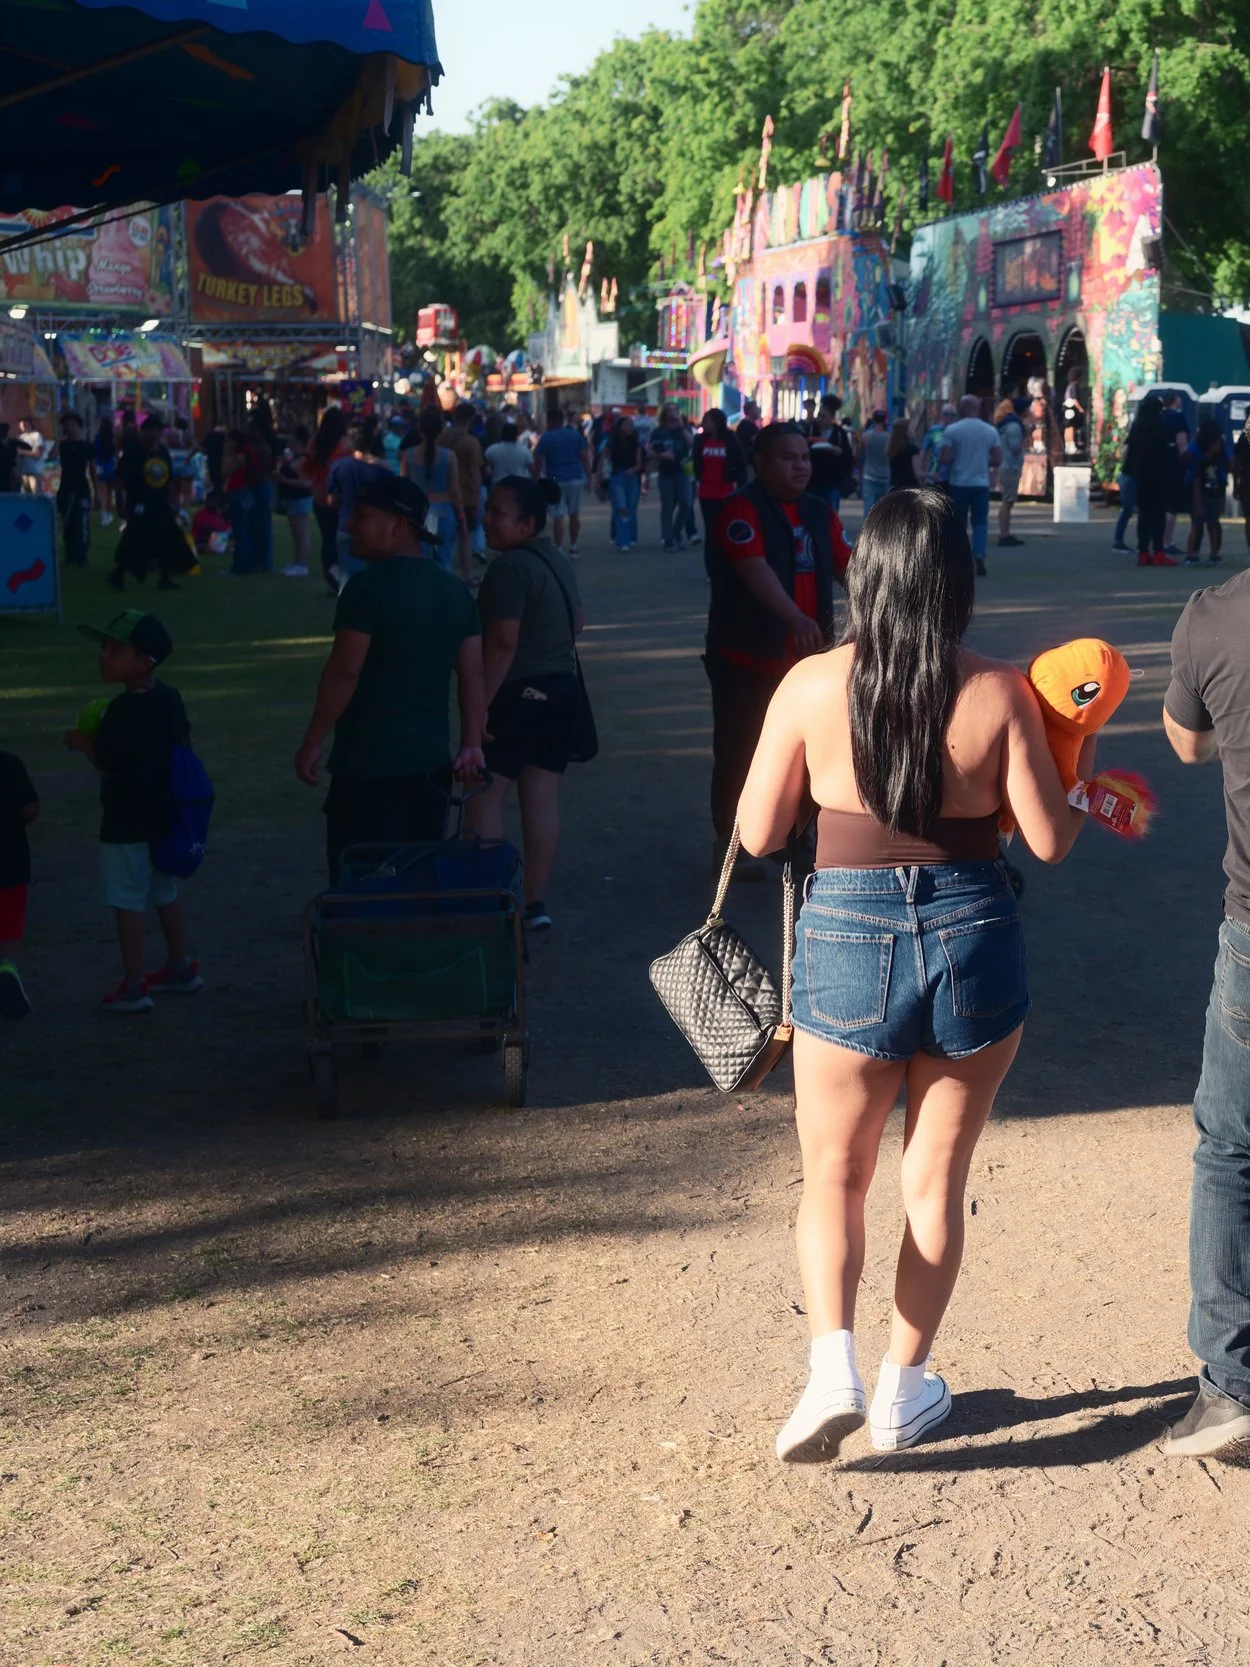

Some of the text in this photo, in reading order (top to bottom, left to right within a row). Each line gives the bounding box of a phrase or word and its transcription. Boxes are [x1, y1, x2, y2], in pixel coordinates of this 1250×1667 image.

[2, 238, 87, 281] Whip
[197, 271, 304, 307] TURKEY LEGS
